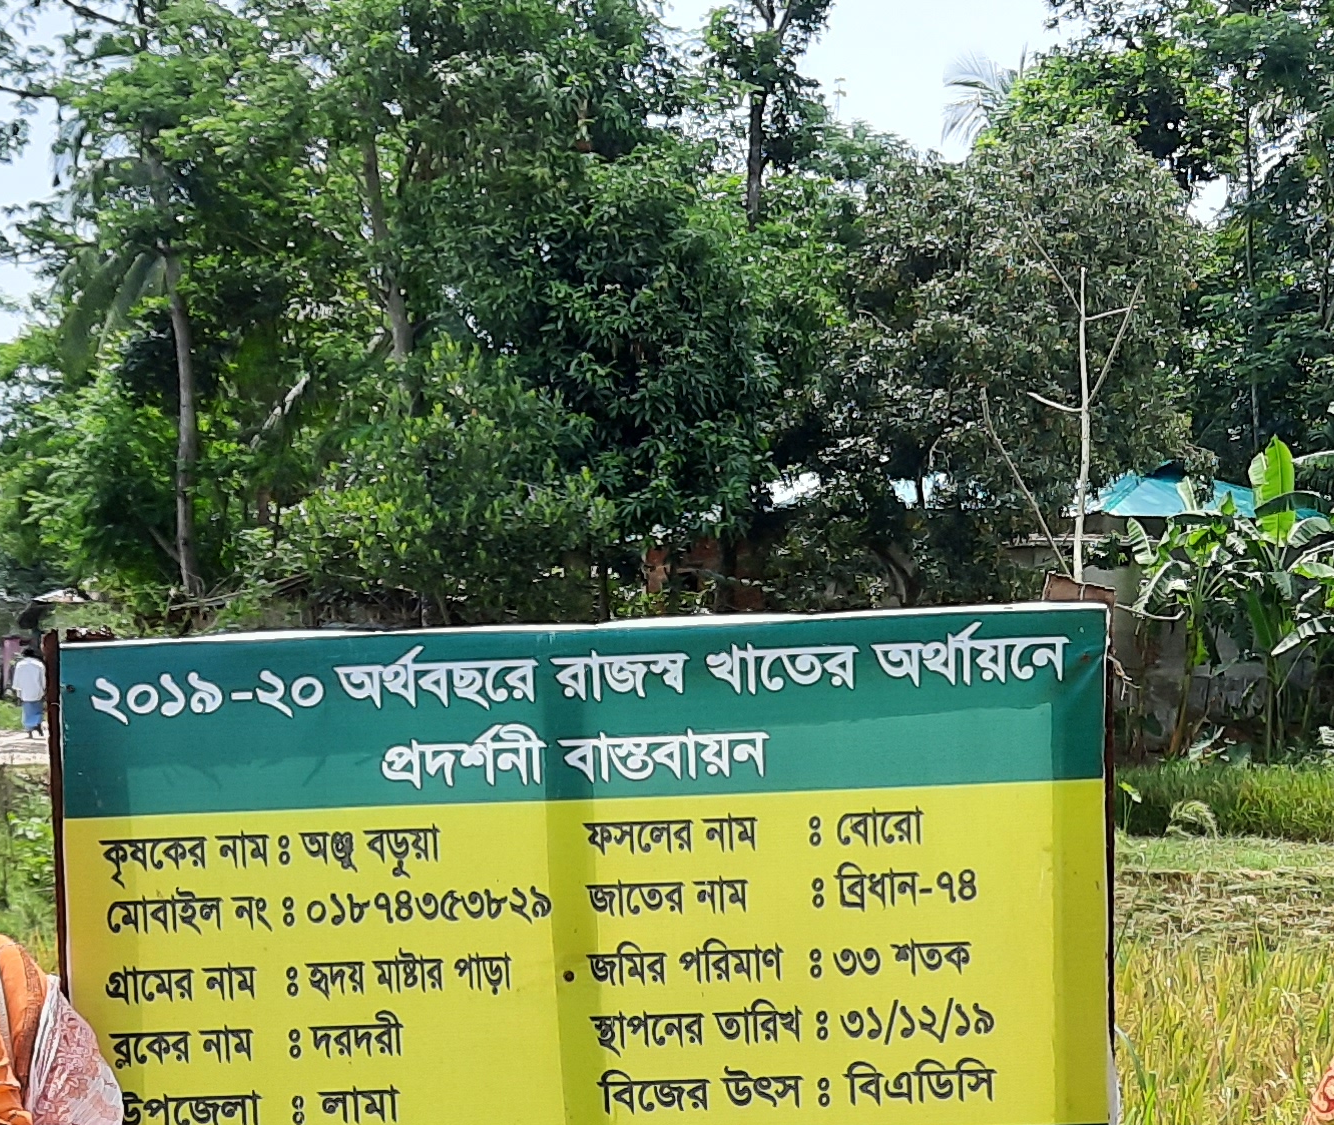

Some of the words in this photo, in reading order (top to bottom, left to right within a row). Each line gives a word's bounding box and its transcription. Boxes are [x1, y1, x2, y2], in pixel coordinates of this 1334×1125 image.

[92, 671, 323, 725] ২০১৯-২০
[334, 646, 538, 709] অর্থবছরে
[550, 651, 689, 701] রাজস্ব
[706, 643, 859, 694] খাতের
[871, 622, 1069, 686] অর্থায়নে
[382, 724, 546, 789] প্রদর্শনী
[558, 729, 769, 783] বাস্তবায়ন
[99, 837, 206, 887] কৃষকের
[215, 831, 269, 868] নাম
[299, 832, 357, 872] অঞ্জু
[363, 824, 439, 877] বড়ুয়া
[583, 820, 693, 854] ফসলের
[702, 814, 757, 850] নাম
[838, 807, 923, 845] বোরো
[107, 887, 222, 934] মোবাইল
[231, 897, 272, 931] নং
[307, 886, 551, 925] ০১৮৭৪৩৫৩৮২৯
[585, 880, 683, 916] জাতের
[693, 876, 747, 913] নাম
[835, 862, 976, 911] ব্রিধান-৭৪
[106, 966, 193, 1005] গ্রামের
[202, 963, 255, 1000] নাম
[305, 962, 364, 998] হৃদয়
[372, 948, 443, 992] মাষ্টার
[455, 952, 511, 995] পাড়া
[586, 941, 666, 985] জমির
[679, 938, 783, 983] পরিমাণ
[834, 948, 880, 975] ৩৩
[891, 939, 971, 975] শতক
[109, 1032, 191, 1069] ব্লকের
[199, 1025, 253, 1063] নাম
[309, 1010, 403, 1057] দরদরী
[589, 1011, 704, 1057] স্থাপনের
[712, 999, 801, 1044] তারিখ
[841, 998, 994, 1044] ৩১/১২/১৯
[318, 1085, 399, 1123] লামা
[596, 1070, 710, 1114] বিজের
[721, 1066, 802, 1107] উৎস
[844, 1058, 996, 1105] বিএডিসি
